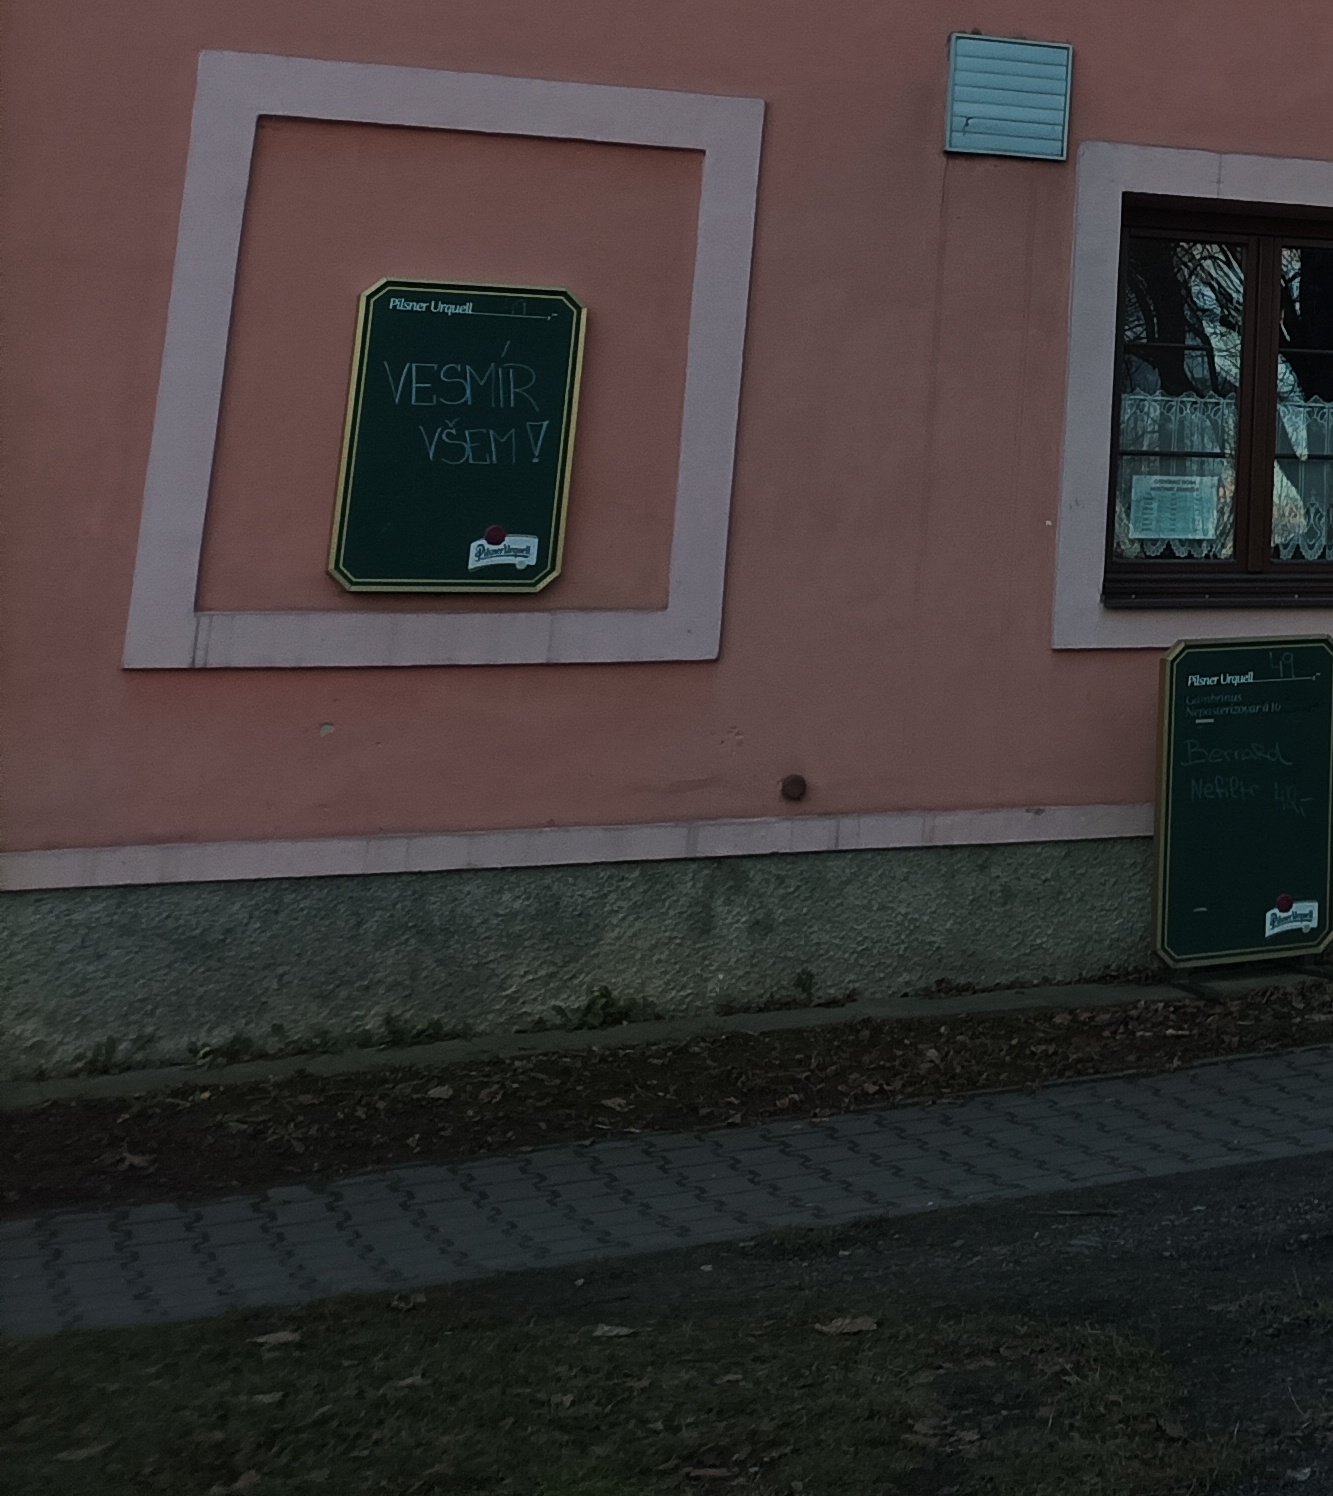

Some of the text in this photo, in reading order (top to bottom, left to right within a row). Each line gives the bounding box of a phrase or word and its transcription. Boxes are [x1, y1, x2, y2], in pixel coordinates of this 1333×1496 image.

[389, 297, 473, 316] Pilsner Urquell
[384, 340, 540, 412] VESMÍR
[1187, 671, 1254, 687] Pilsner Urquell
